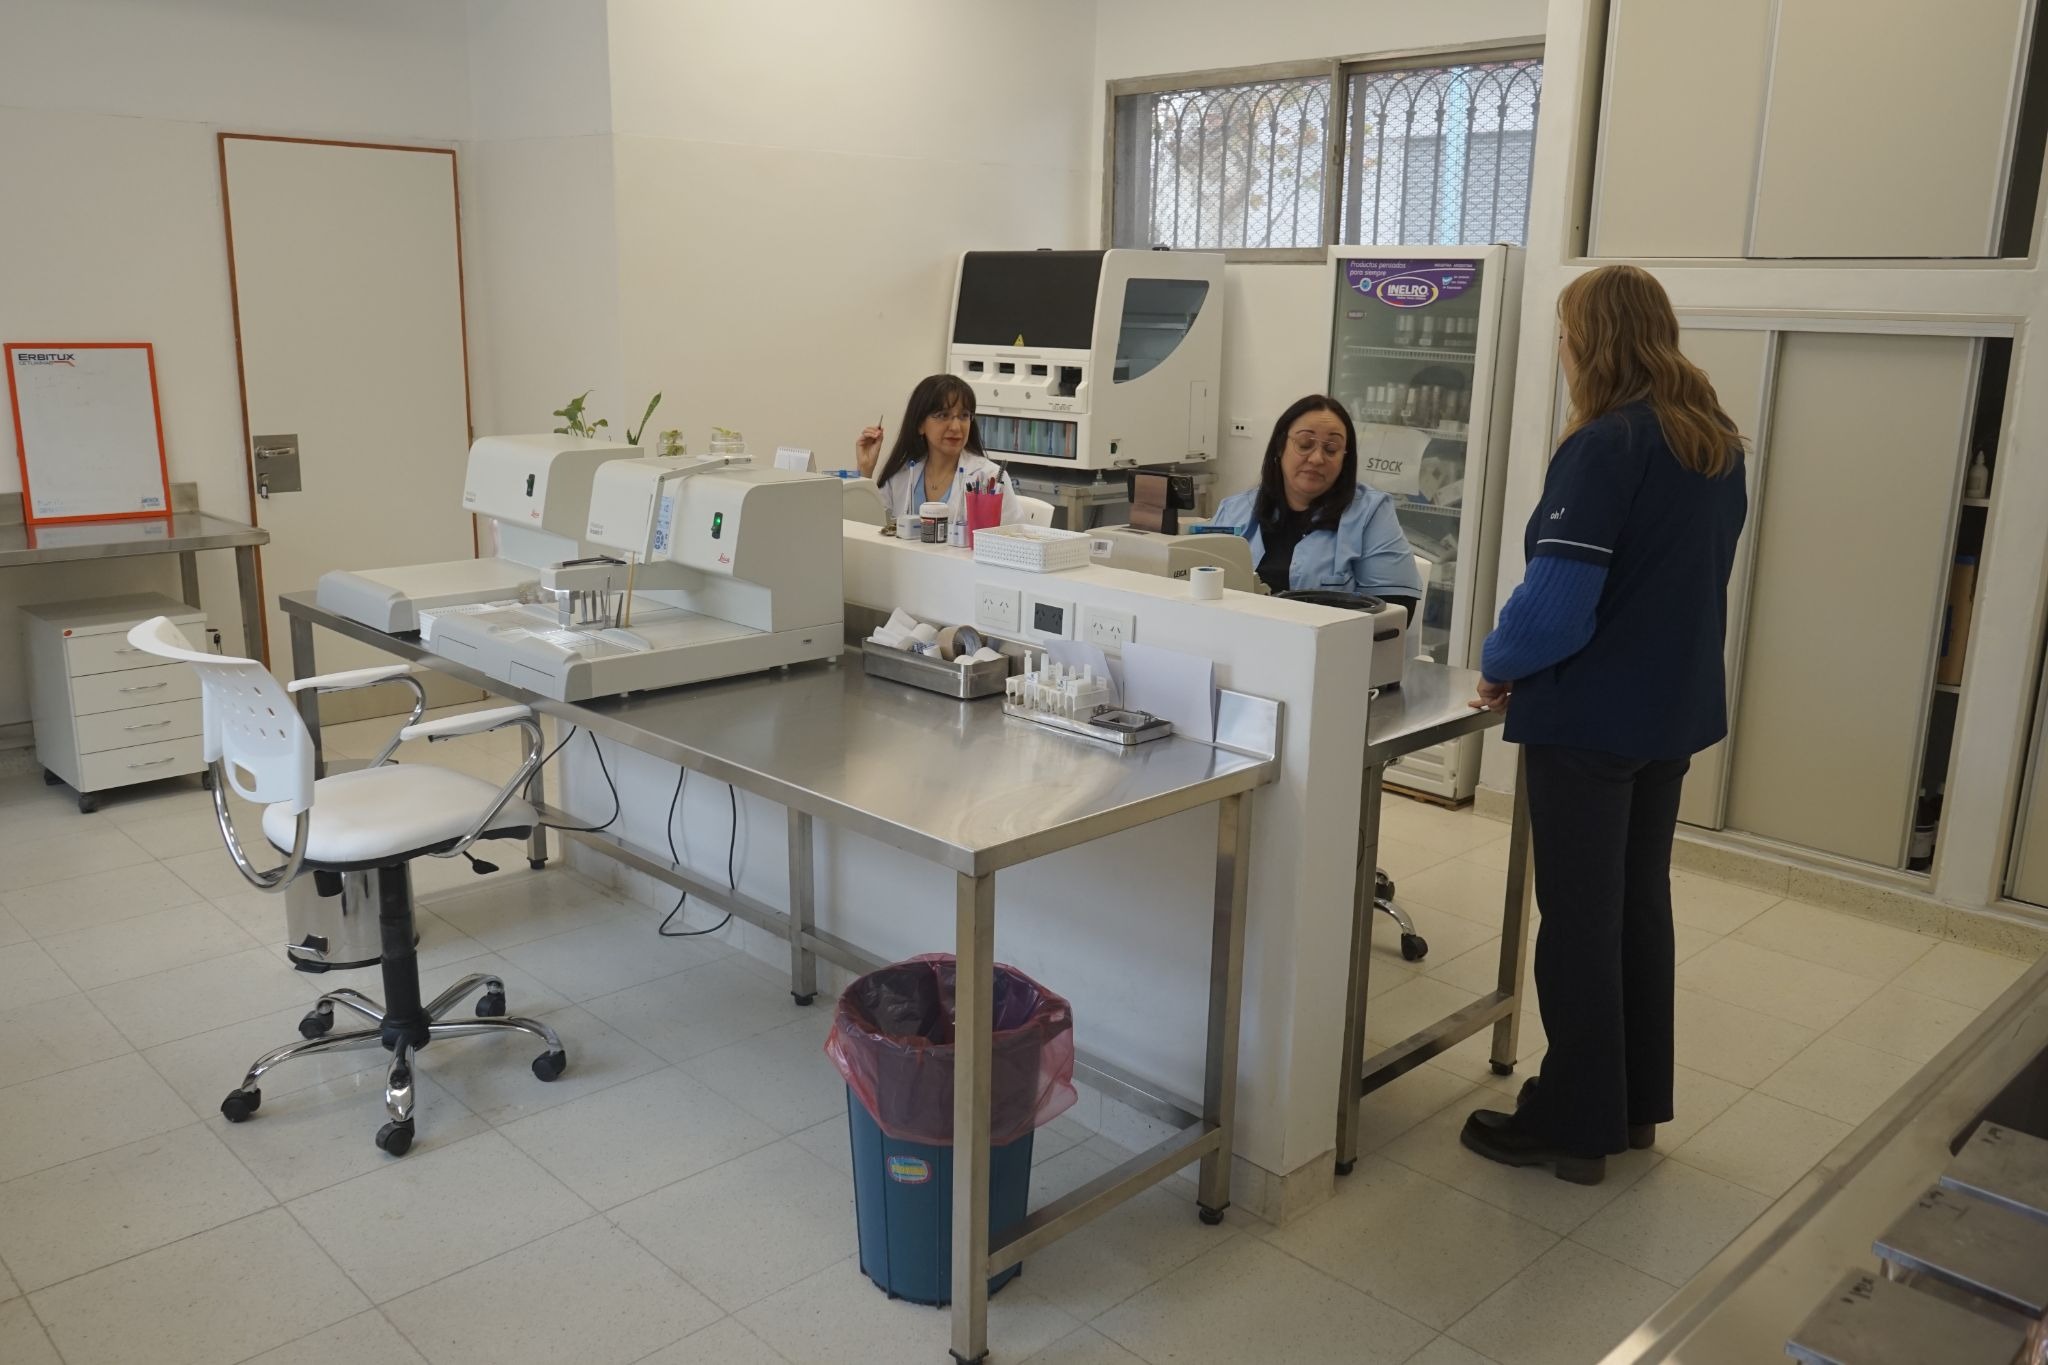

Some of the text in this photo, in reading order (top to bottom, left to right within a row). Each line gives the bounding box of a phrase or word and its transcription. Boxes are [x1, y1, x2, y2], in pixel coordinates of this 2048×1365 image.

[1387, 284, 1428, 296] INELRO
[18, 353, 76, 361] ERBITUX
[1366, 457, 1403, 473] STOCK
